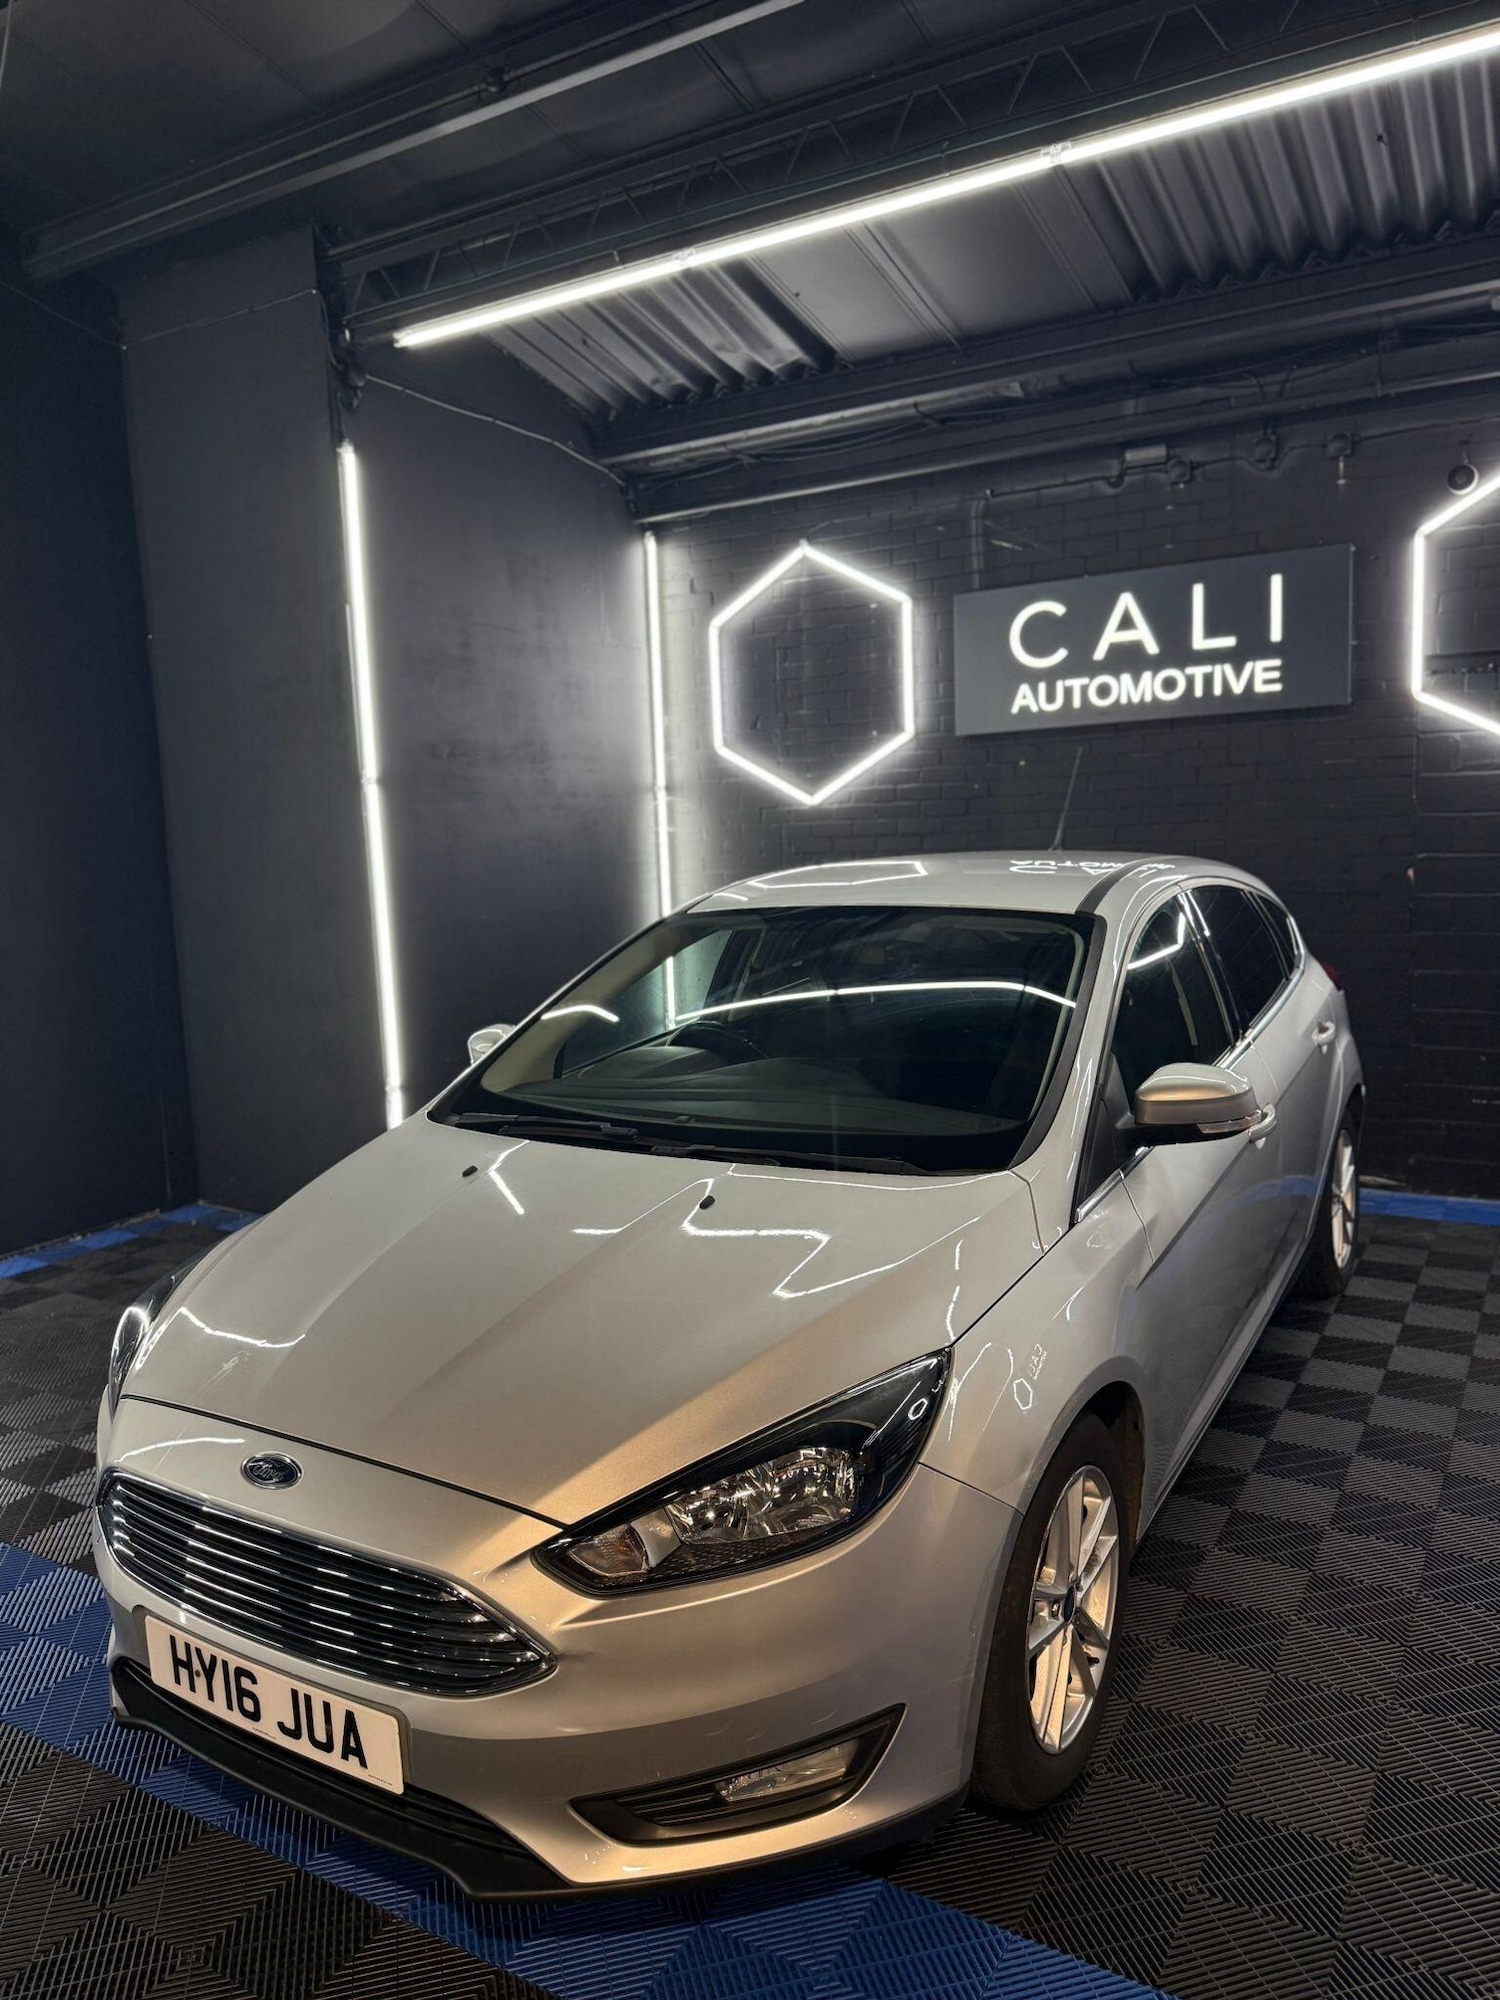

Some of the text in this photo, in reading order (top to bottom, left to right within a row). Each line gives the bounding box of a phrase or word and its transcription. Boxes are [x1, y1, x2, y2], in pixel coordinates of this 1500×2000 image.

[1009, 573, 1283, 669] CALI
[1010, 658, 1283, 715] AUTOMOTIVE
[169, 1634, 369, 1770] HY16 JUA
